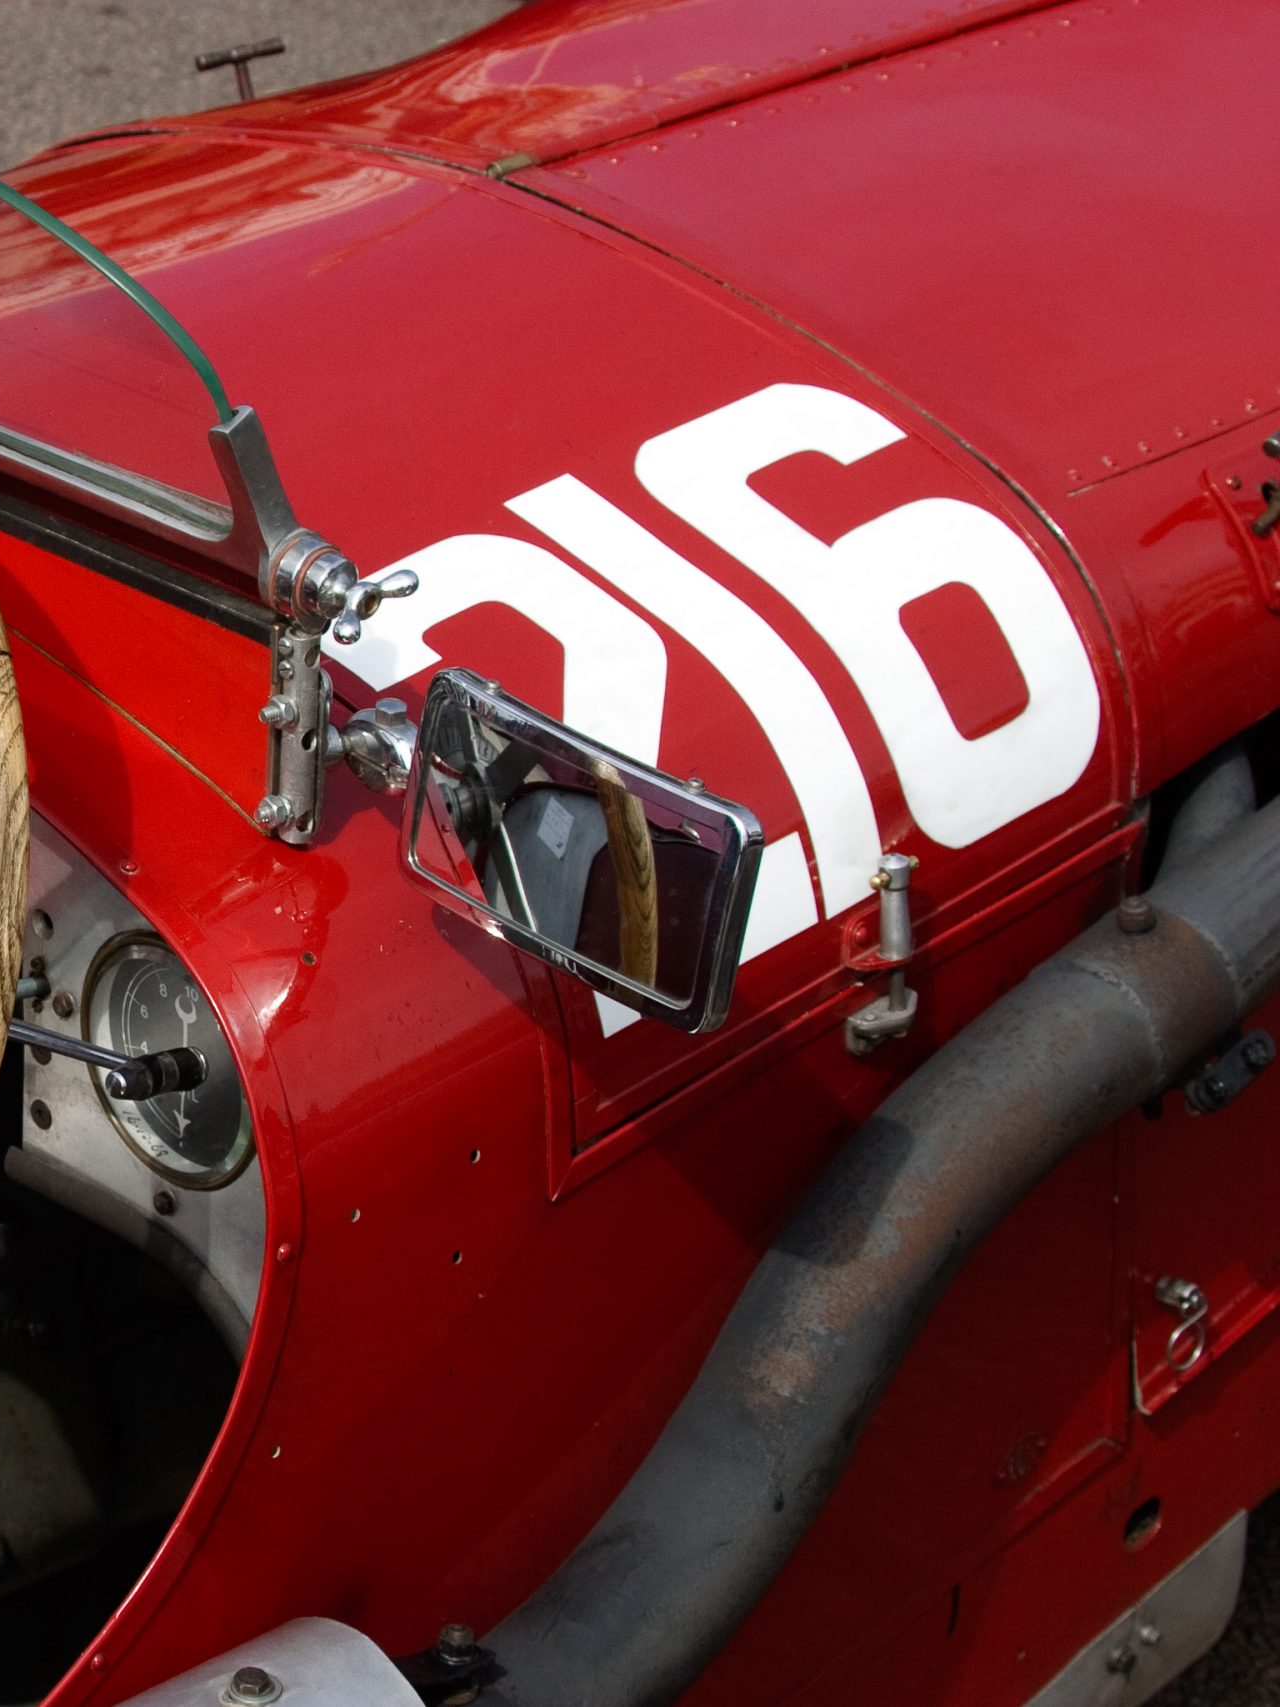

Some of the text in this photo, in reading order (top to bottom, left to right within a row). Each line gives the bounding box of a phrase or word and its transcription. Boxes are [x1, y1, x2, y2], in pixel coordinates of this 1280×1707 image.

[158, 983, 168, 998] 8
[183, 985, 199, 1002] 10
[140, 1004, 149, 1019] 6
[140, 1041, 148, 1055] 4
